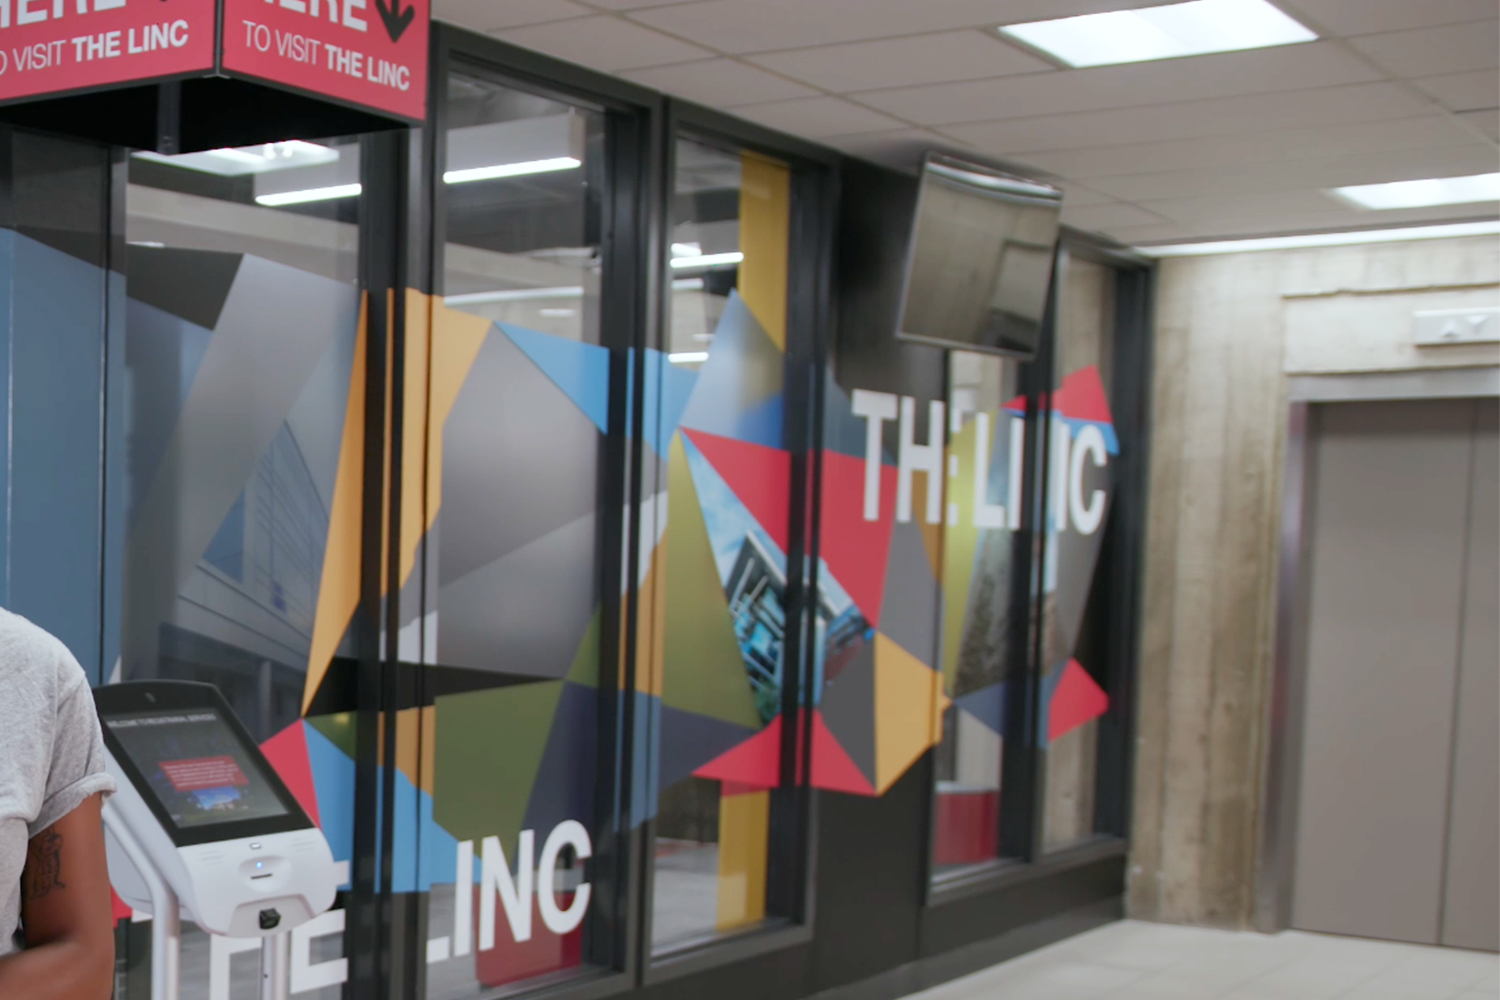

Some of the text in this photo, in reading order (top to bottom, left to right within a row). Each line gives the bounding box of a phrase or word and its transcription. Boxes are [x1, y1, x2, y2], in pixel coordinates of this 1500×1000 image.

[13, 40, 66, 71] VISIT
[71, 30, 121, 62] THE
[128, 19, 189, 54] LINC
[242, 20, 410, 91] TO VISIT THE LINC
[427, 819, 592, 963] INC
